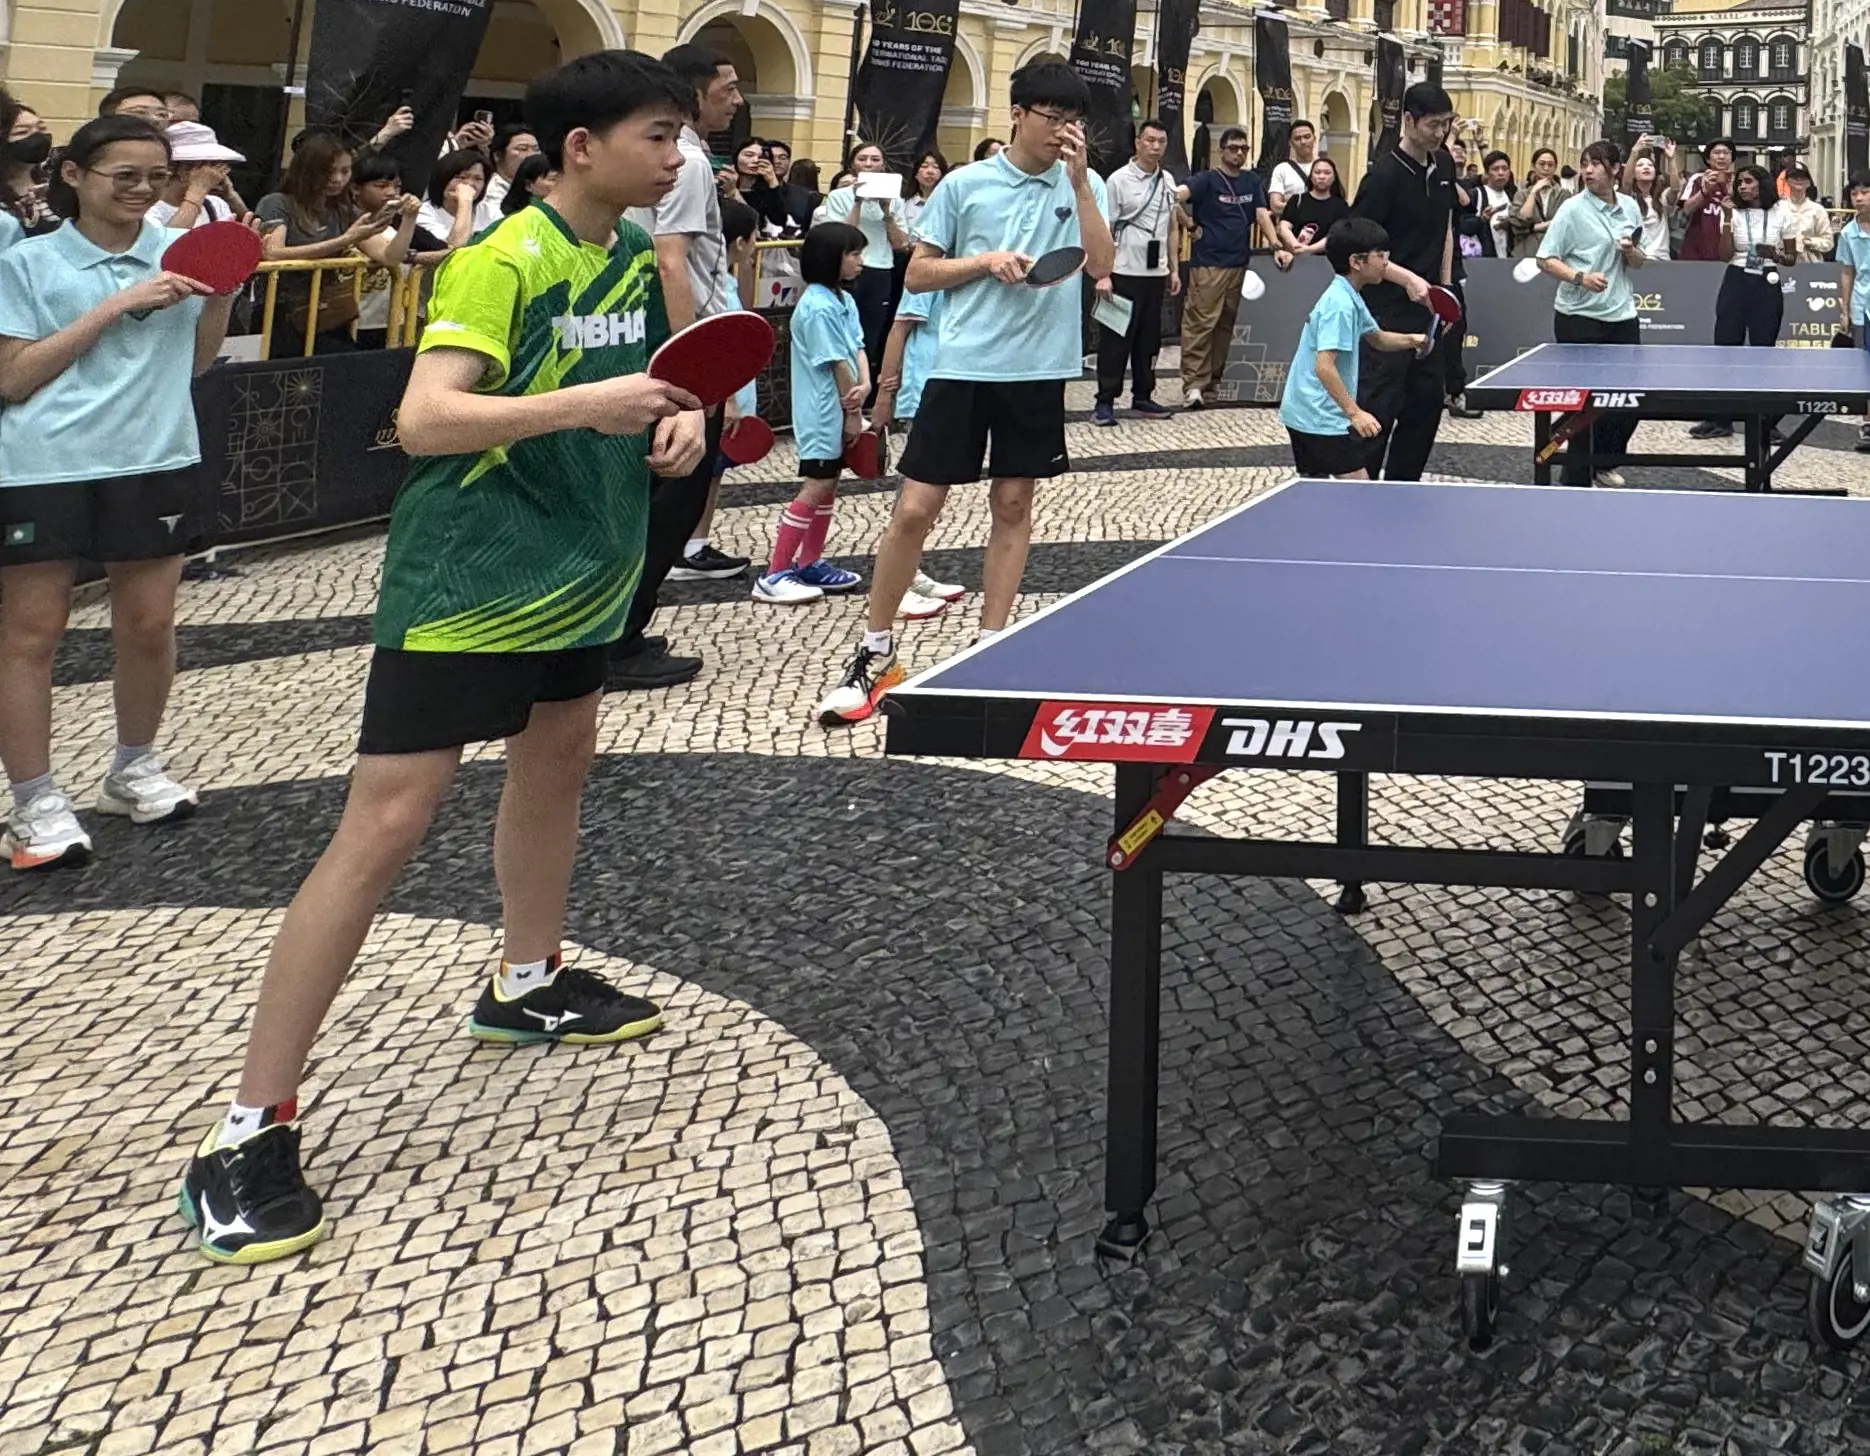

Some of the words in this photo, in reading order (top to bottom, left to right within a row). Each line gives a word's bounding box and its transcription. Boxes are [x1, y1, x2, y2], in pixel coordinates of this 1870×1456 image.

[1591, 392, 1646, 408] DHS
[1797, 400, 1838, 413] T1223
[1050, 708, 1194, 748] 红双喜
[1220, 717, 1363, 759] DHS
